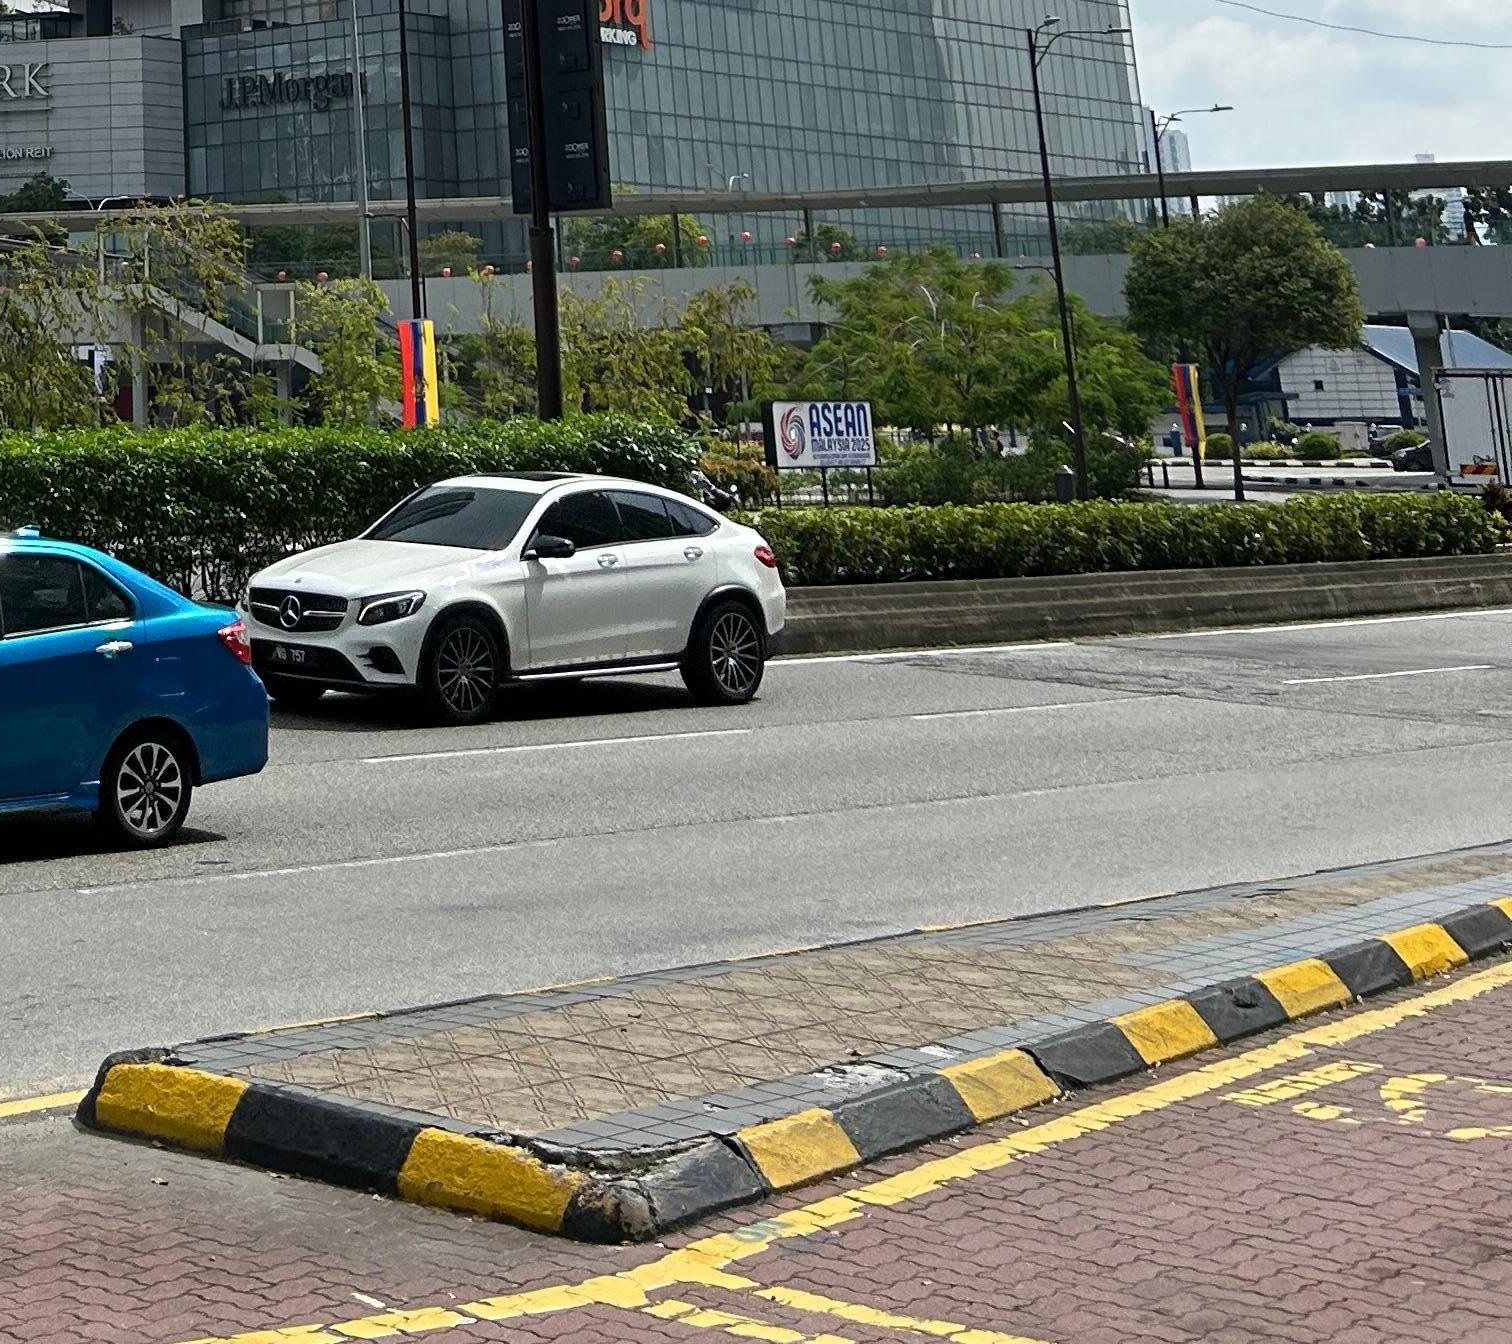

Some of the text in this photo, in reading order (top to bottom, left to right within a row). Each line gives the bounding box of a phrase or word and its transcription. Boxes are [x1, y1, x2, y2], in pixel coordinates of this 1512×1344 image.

[600, 27, 637, 46] RKING
[26, 146, 53, 159] REIT
[808, 402, 869, 437] ASEAN
[850, 437, 871, 452] 2025
